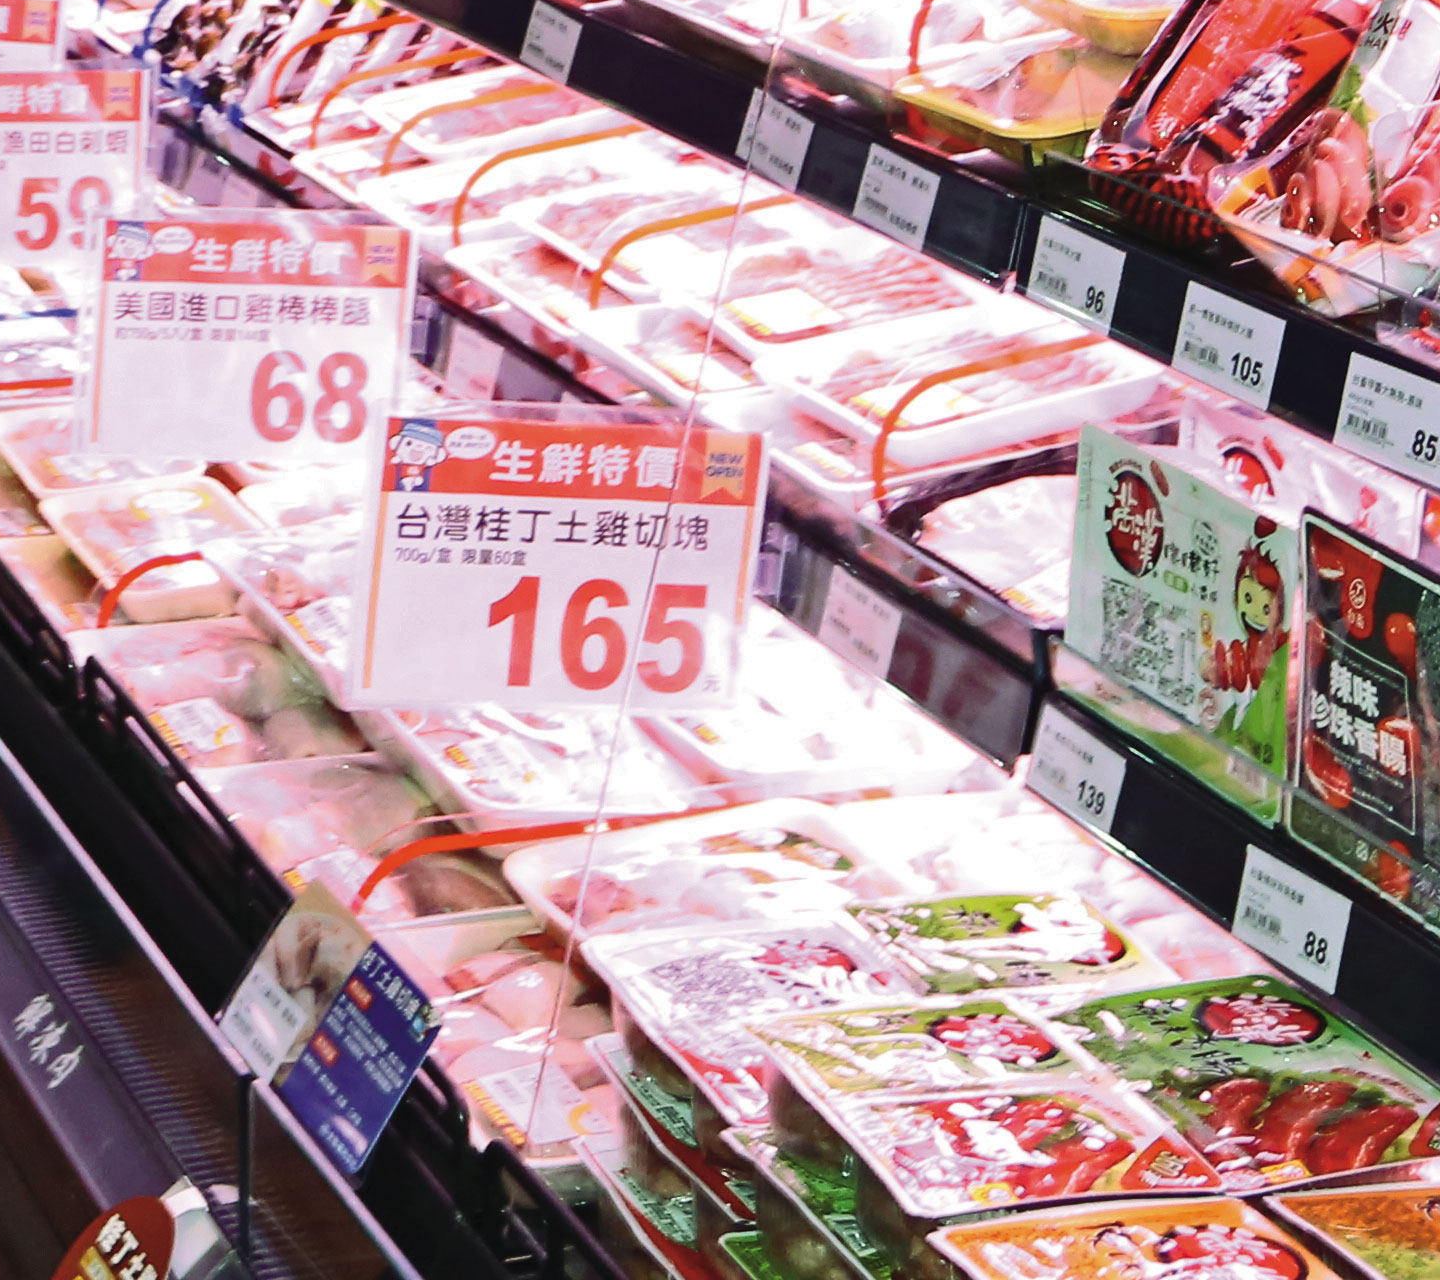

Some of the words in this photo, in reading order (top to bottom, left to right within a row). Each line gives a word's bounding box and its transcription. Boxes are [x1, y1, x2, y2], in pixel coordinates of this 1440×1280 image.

[188, 237, 358, 277] 生鮮特價
[1085, 285, 1105, 315] 96
[1230, 351, 1263, 389] 105
[250, 350, 369, 444] 68
[489, 439, 682, 490] 生鮮特價
[1411, 429, 1439, 463] 85
[395, 503, 710, 551] 台灣桂丁土雞切塊
[487, 575, 709, 694] 165
[1076, 777, 1107, 815] 139
[1304, 930, 1328, 965] 88
